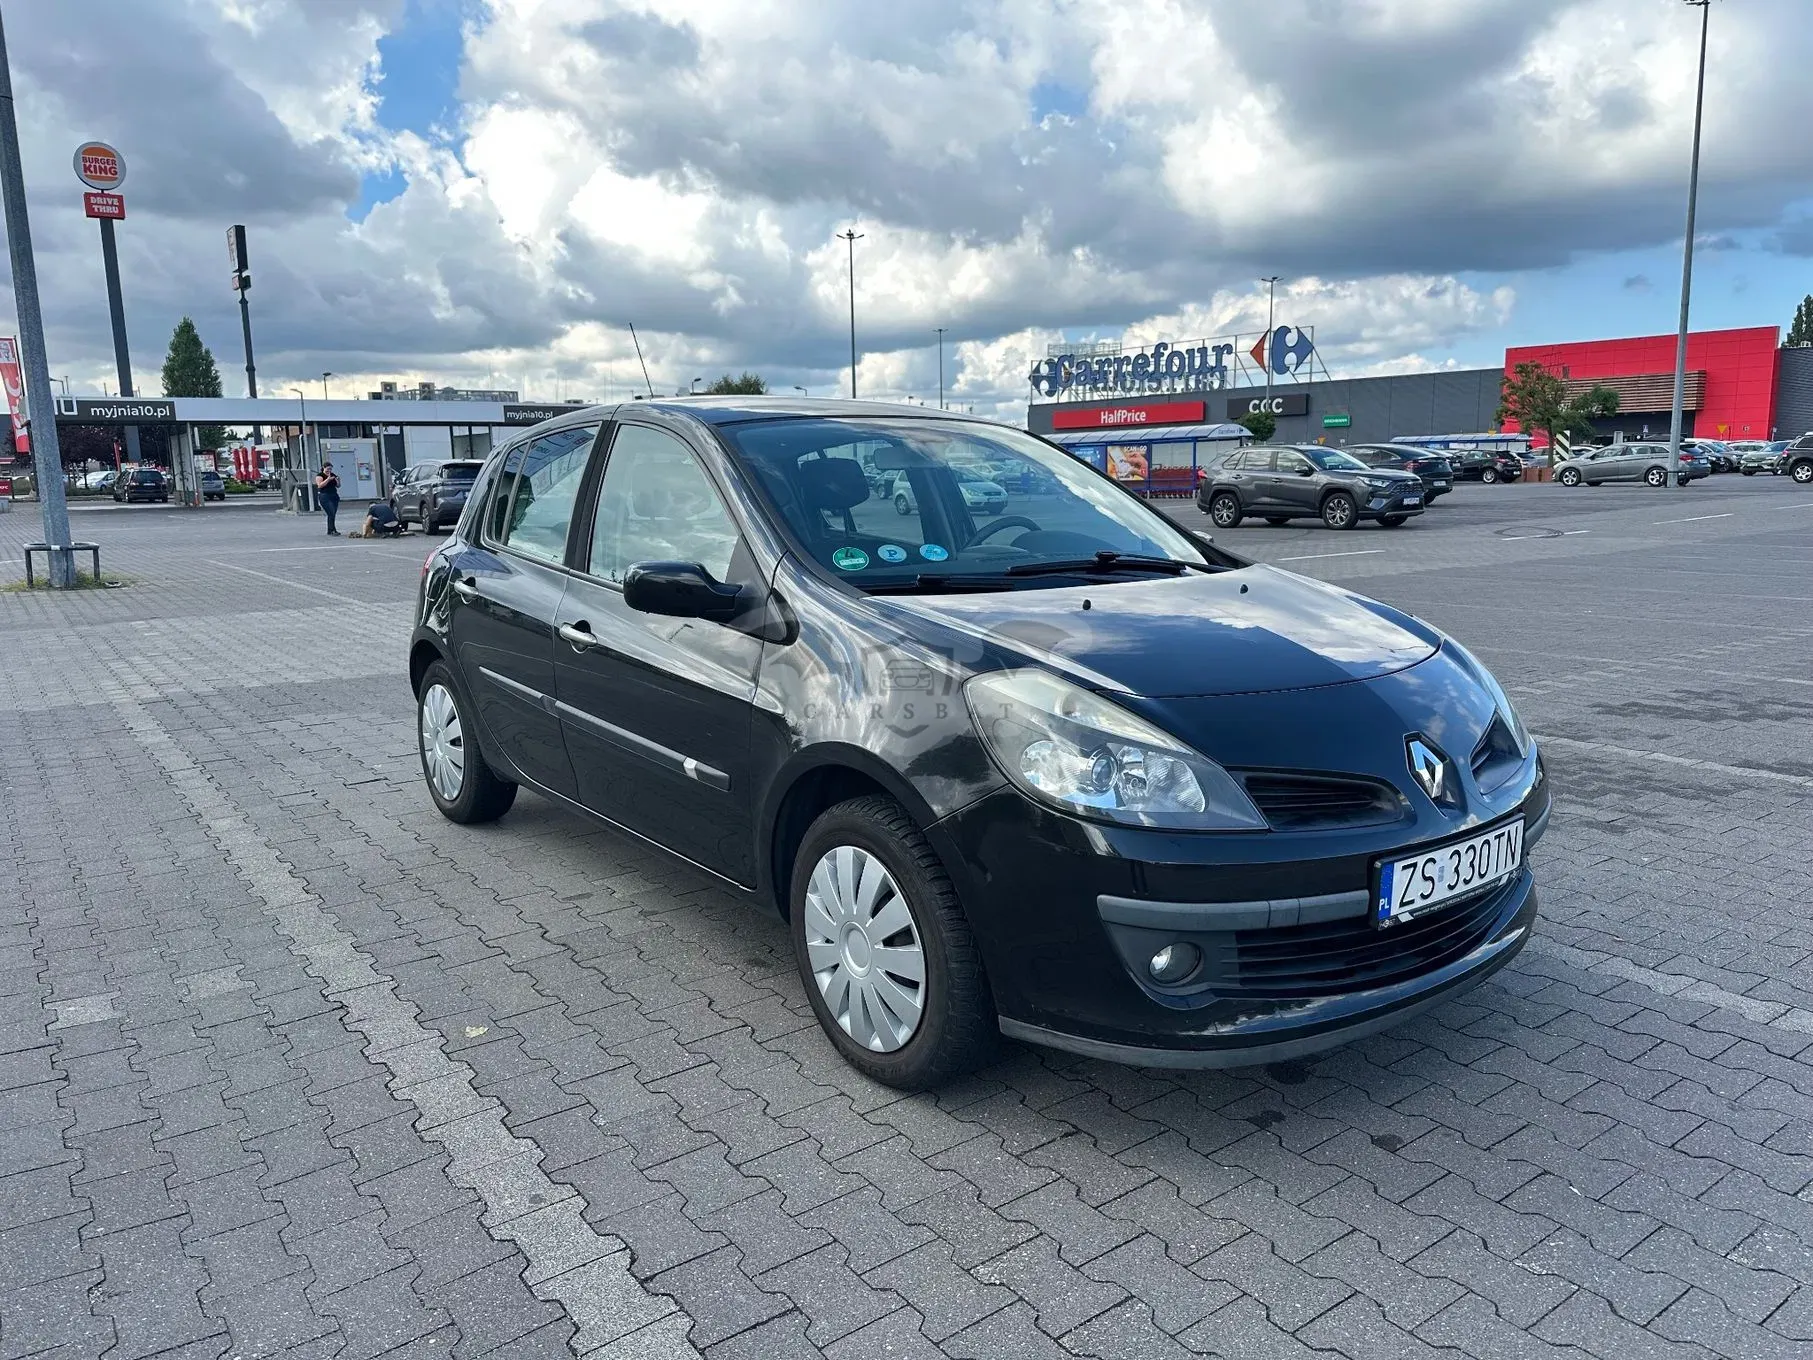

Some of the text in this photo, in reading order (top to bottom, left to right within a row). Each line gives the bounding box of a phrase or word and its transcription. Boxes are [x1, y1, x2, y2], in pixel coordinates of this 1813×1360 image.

[82, 156, 117, 166] BURGER
[83, 164, 118, 176] KING
[90, 197, 119, 206] DRIVE
[92, 205, 119, 214] THRU
[1055, 342, 1233, 388] Carrefour
[91, 405, 170, 418] myjnia10.pl
[1249, 398, 1283, 414] CCC
[506, 411, 553, 420] myjnia10.pl
[1100, 409, 1147, 424] HalfPrice
[1398, 856, 1437, 909] ZS
[1446, 825, 1519, 891] 330TN
[1378, 898, 1390, 910] PL
